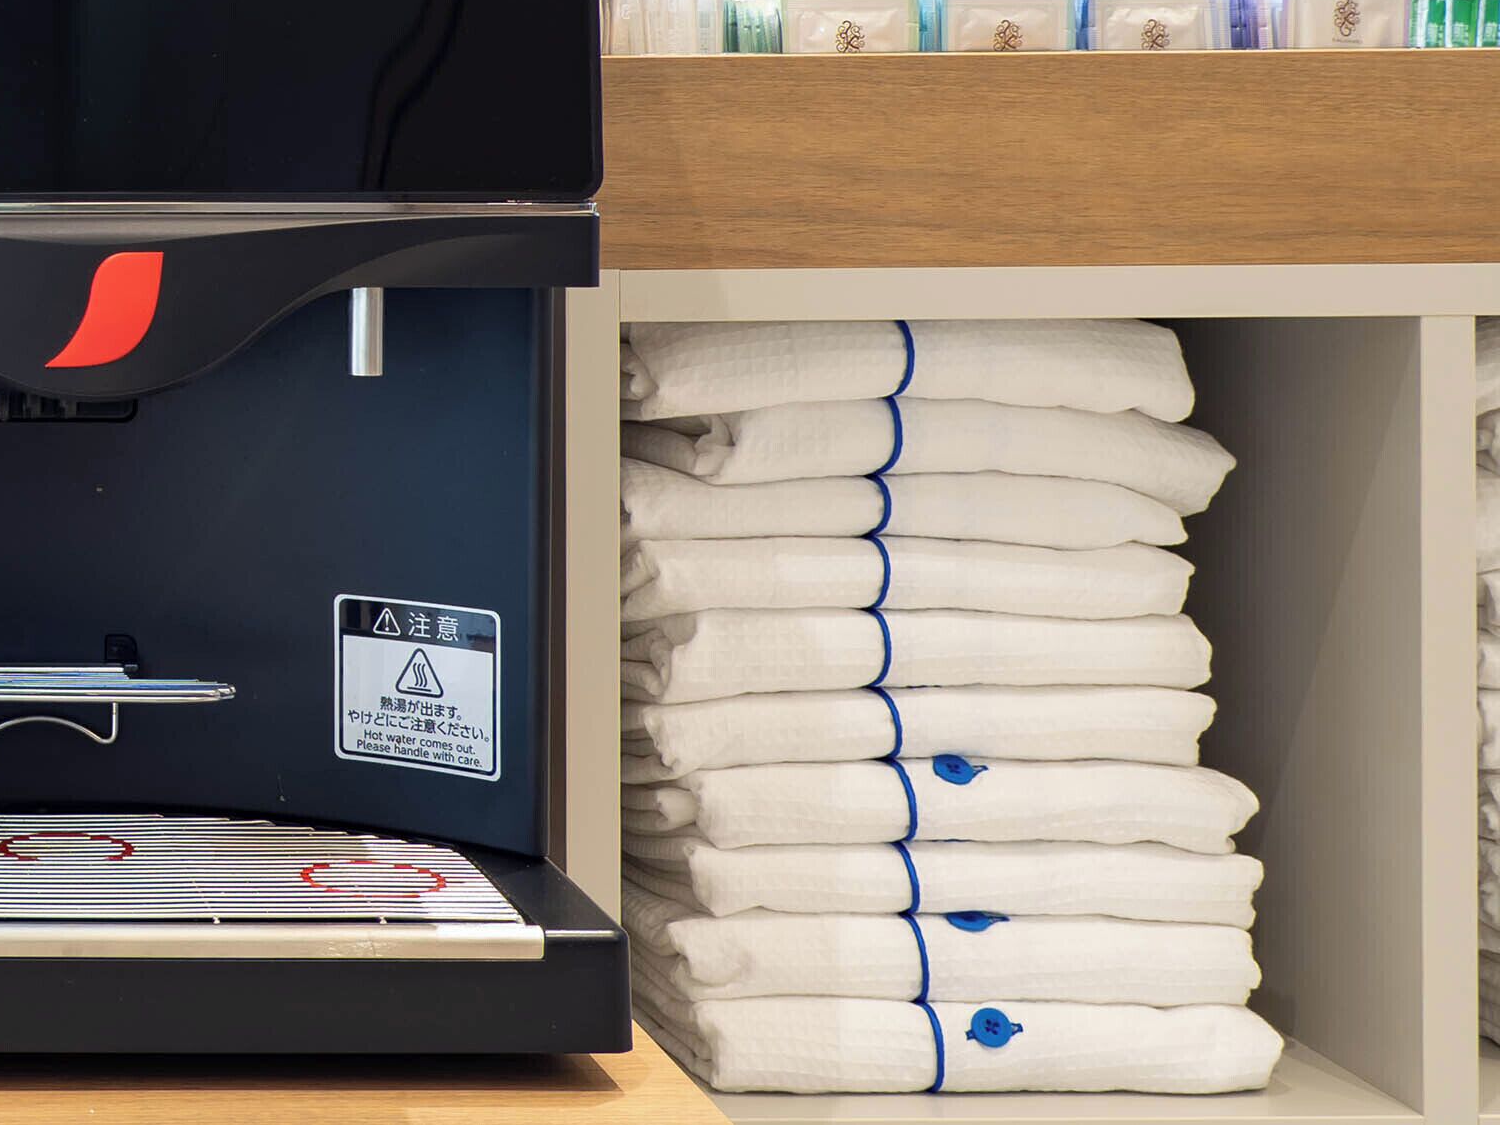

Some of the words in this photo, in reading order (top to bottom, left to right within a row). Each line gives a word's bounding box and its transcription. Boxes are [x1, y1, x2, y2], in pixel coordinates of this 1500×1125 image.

[408, 612, 459, 642] 注意
[380, 696, 462, 721] 熱湯が出ます。
[348, 710, 489, 742] やけどにご注意ください。
[357, 740, 391, 753] Please
[394, 744, 430, 758] handle
[433, 750, 455, 763] with
[458, 755, 483, 768] care.
[364, 730, 383, 741] Hot
[386, 733, 417, 746] water
[420, 738, 453, 751] comes
[456, 743, 476, 755] out.
